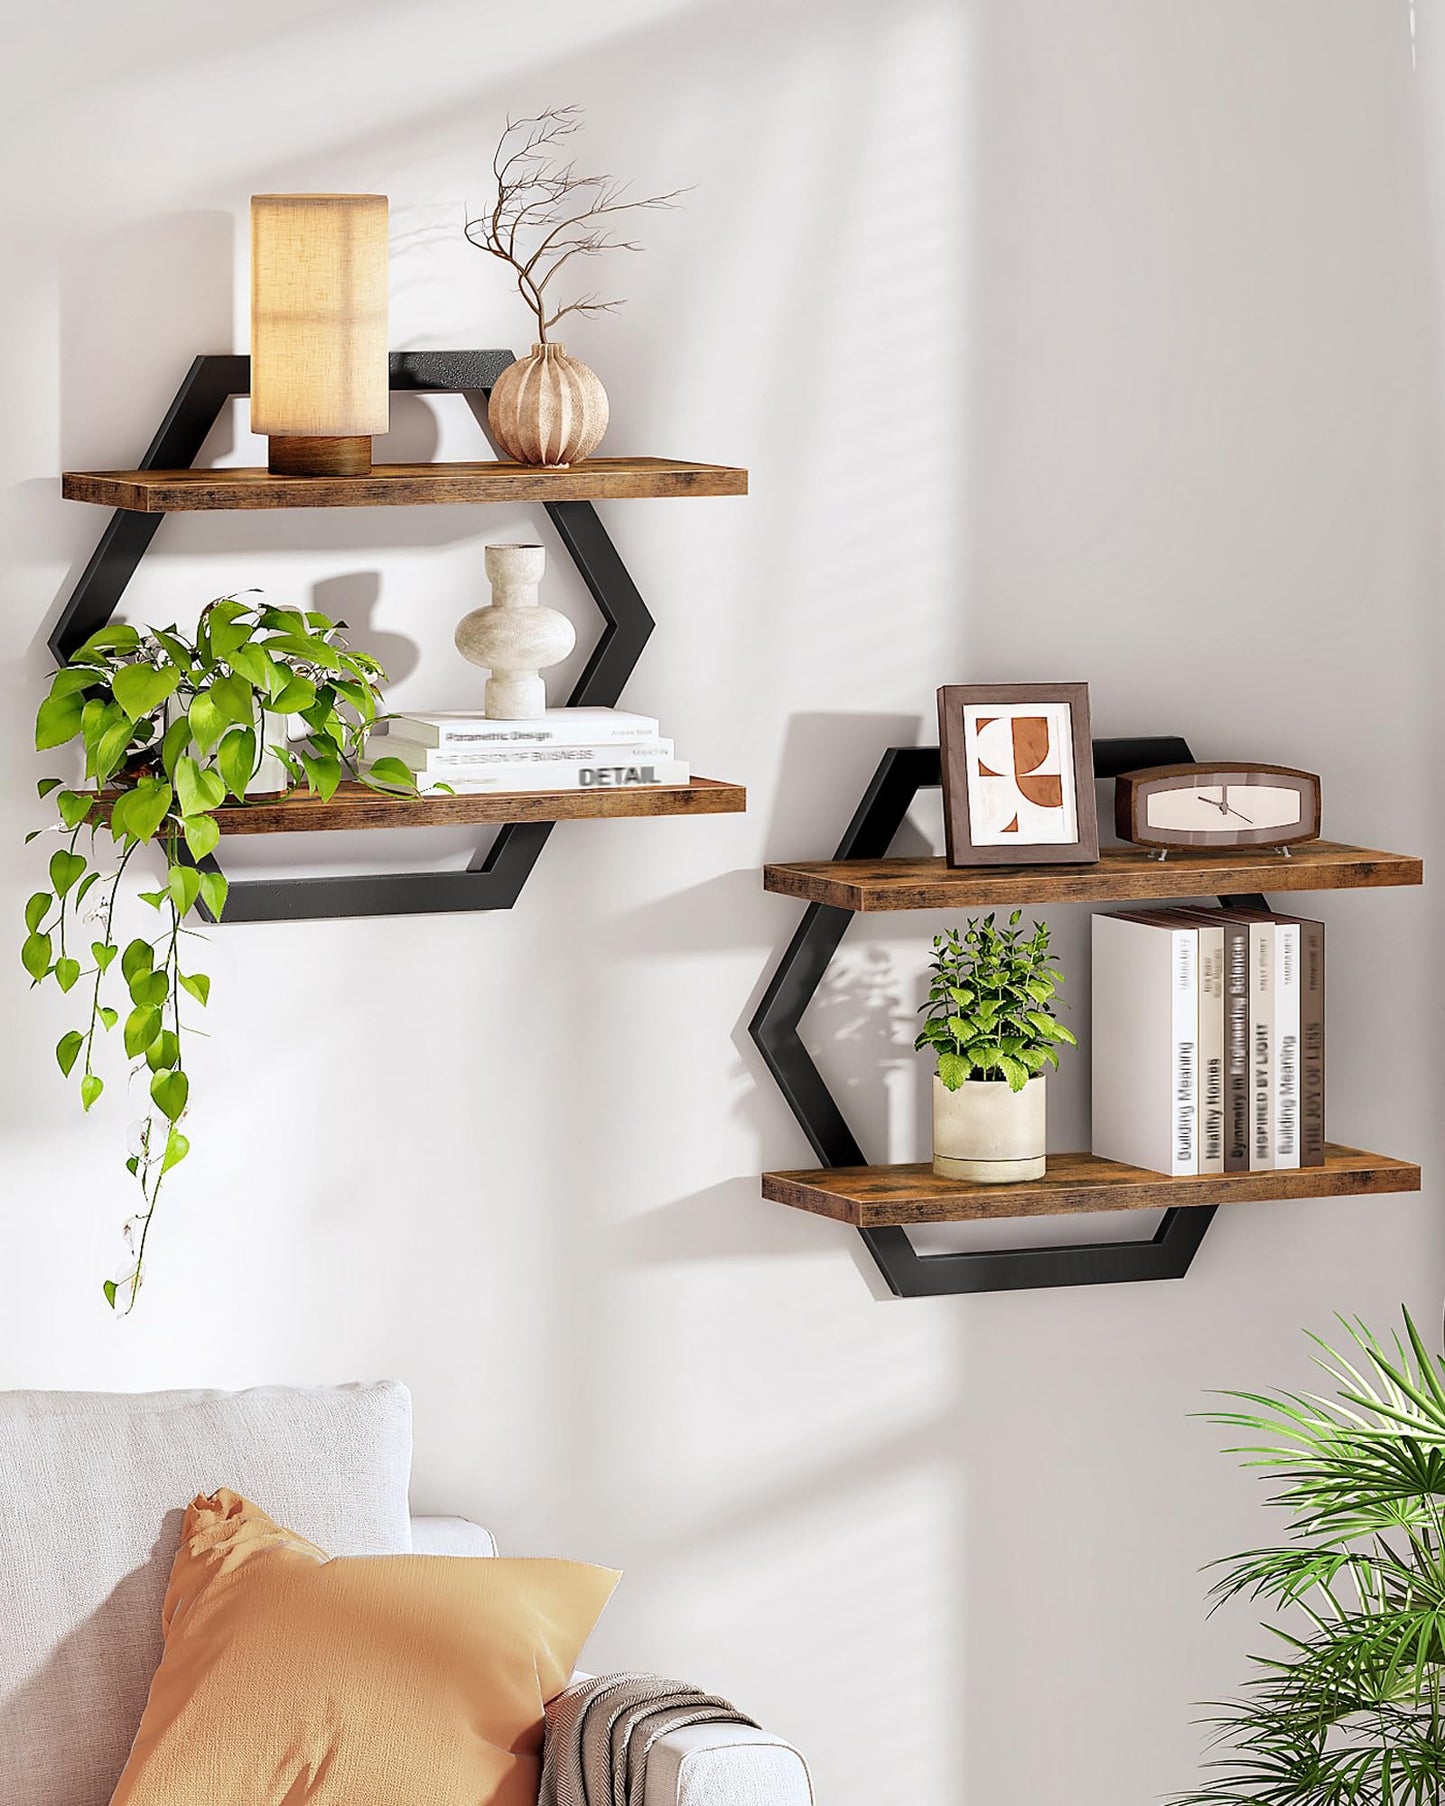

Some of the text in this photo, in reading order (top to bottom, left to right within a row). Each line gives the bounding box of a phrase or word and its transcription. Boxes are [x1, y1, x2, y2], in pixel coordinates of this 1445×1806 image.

[511, 731, 553, 742] Design
[536, 749, 594, 762] BUSINESS
[578, 765, 662, 787] DETAIL
[1229, 936, 1245, 994] Sciences
[1229, 997, 1247, 1075] Engineering
[1177, 1041, 1195, 1161] Building Meaning
[1206, 1058, 1224, 1159] Healthy Homes
[1231, 1094, 1247, 1158] Symmetry
[1256, 1023, 1269, 1159] INSPIRED BY LIGHT
[1278, 1036, 1297, 1154] Building Meaning
[1305, 1022, 1321, 1155] THE JOY OF LESS
